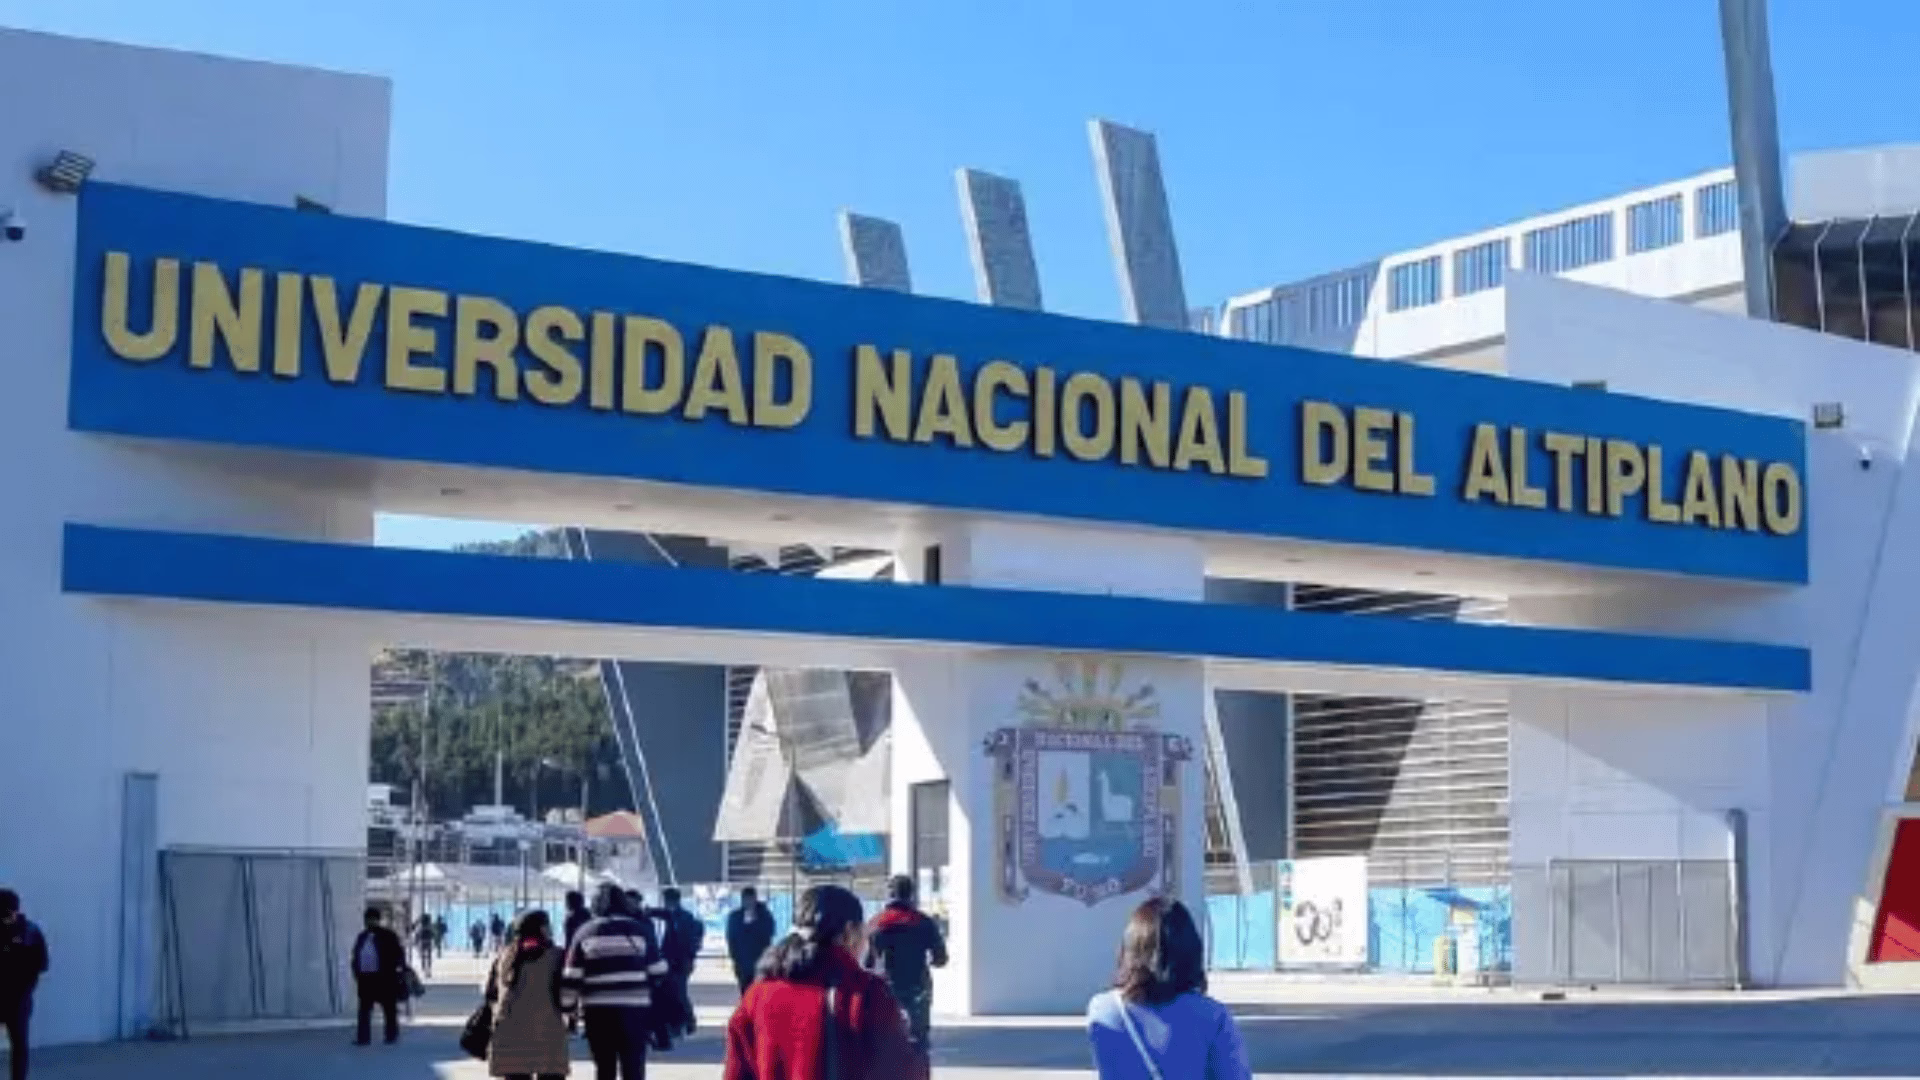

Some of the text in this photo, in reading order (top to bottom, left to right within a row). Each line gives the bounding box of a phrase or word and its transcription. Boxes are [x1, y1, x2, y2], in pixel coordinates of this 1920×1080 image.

[102, 251, 1801, 536] UNIVERSIDAD NACIONAL DEL ALTIPLANO
